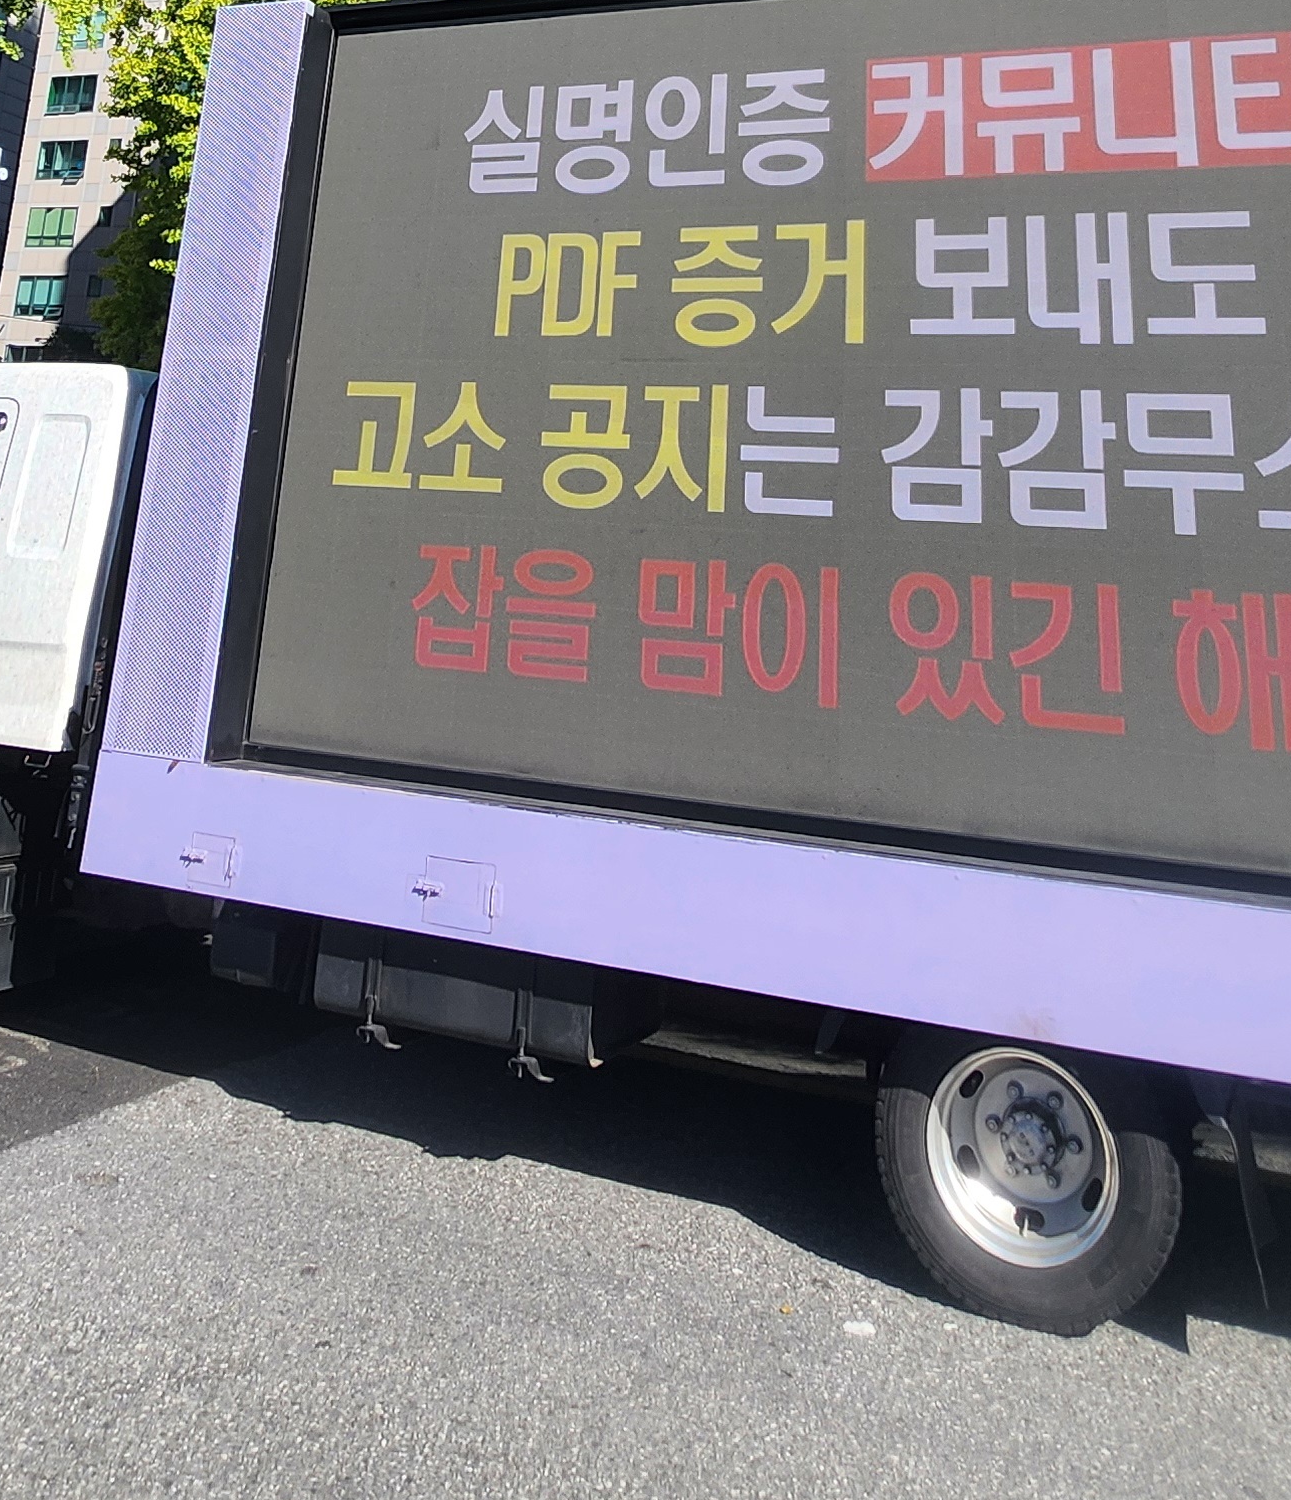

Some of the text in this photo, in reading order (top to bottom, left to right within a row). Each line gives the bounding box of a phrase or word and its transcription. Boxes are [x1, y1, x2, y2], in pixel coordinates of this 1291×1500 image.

[464, 68, 831, 194] 실명인증
[495, 210, 1268, 347] PDF 증거 보내도
[332, 381, 506, 495] 고소
[541, 384, 840, 518] 공지는
[411, 544, 597, 682] 잡을
[637, 559, 840, 709] 맘이
[889, 572, 1126, 735] 있긴
